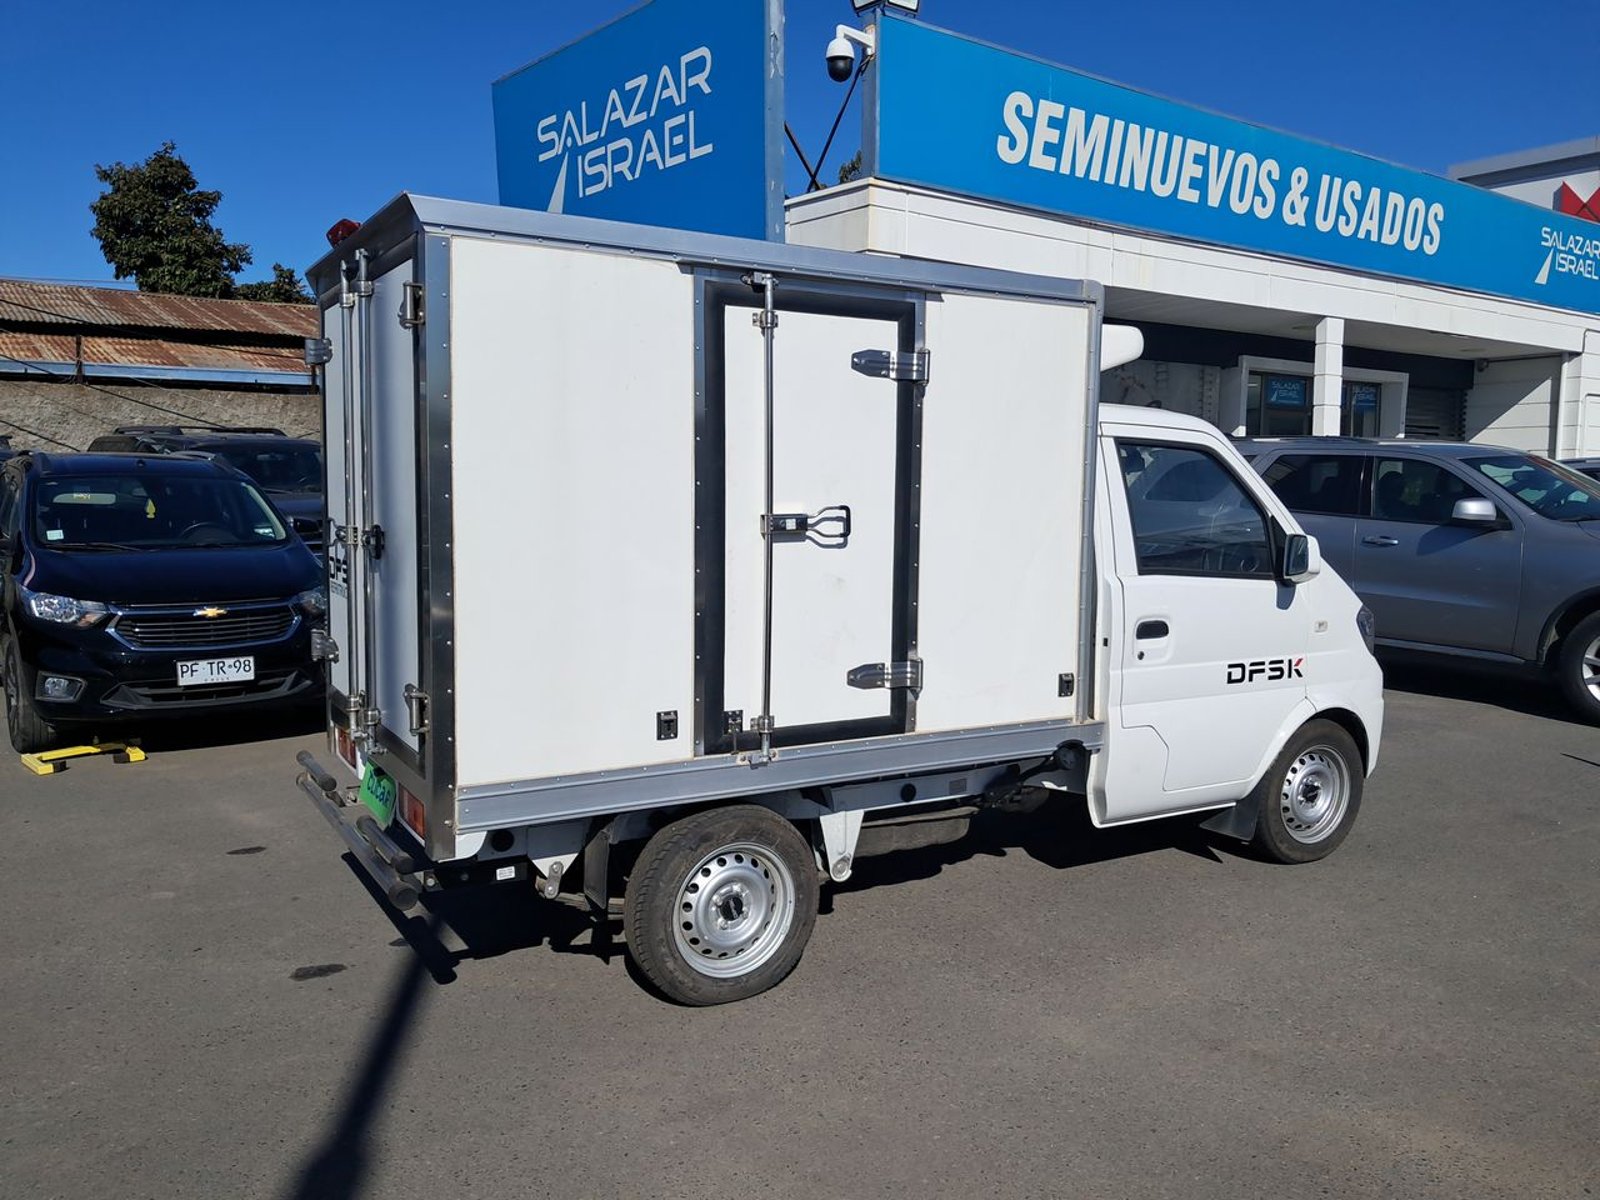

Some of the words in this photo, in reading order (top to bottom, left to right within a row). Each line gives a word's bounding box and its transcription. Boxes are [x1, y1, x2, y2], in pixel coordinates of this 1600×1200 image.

[536, 45, 713, 162] SALAZAR
[577, 109, 714, 198] ISRAEL
[996, 90, 1280, 221] SEMINUEVOS
[1282, 166, 1308, 227] &
[1314, 173, 1445, 256] USADOS
[1540, 226, 1600, 259] SALAZAR
[1555, 251, 1599, 280] ISRAEL
[1226, 657, 1303, 685] DFSK
